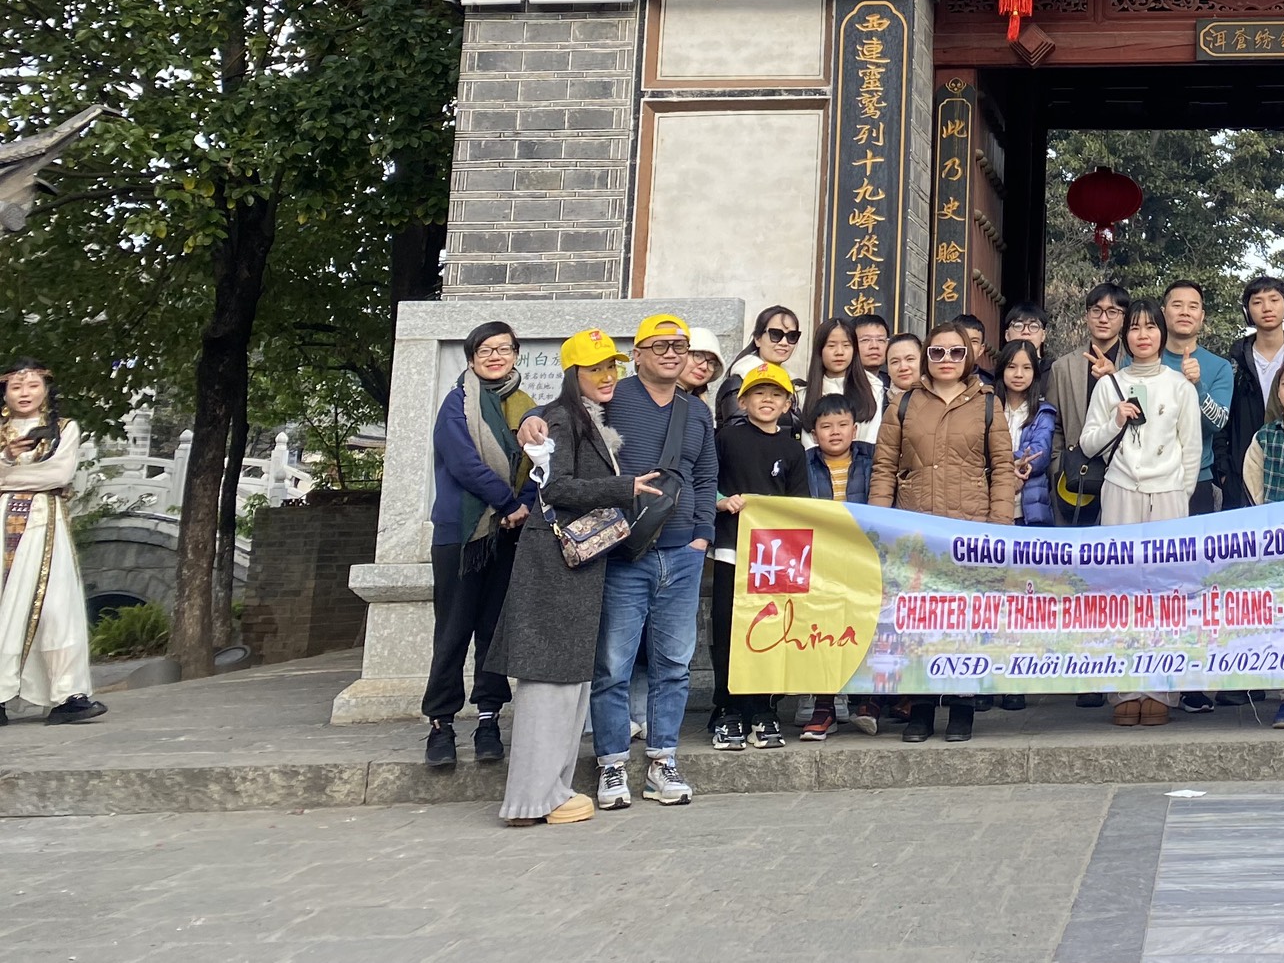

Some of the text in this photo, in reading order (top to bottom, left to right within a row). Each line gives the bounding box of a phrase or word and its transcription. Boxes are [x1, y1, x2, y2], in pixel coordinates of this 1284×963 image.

[750, 539, 811, 588] Hi!
[953, 534, 1006, 564] CHÀO
[1013, 538, 1073, 565] MỪNG
[1079, 538, 1134, 565] ĐOÀN
[1141, 537, 1197, 563] THAM
[1203, 531, 1256, 562] QUAN
[746, 598, 859, 653] China
[896, 595, 967, 630] CHARTER
[971, 595, 1004, 630] BAY
[1062, 594, 1129, 629] BAMBOO
[1134, 589, 1155, 628] HÀ
[1160, 589, 1187, 636] NỘI
[1202, 586, 1220, 635] LỆ
[1225, 590, 1273, 626] GIANG
[929, 655, 989, 676] 6N5Đ
[1009, 654, 1060, 676] Khởi
[1065, 655, 1125, 675] hành:
[1132, 653, 1186, 674] 11/02
